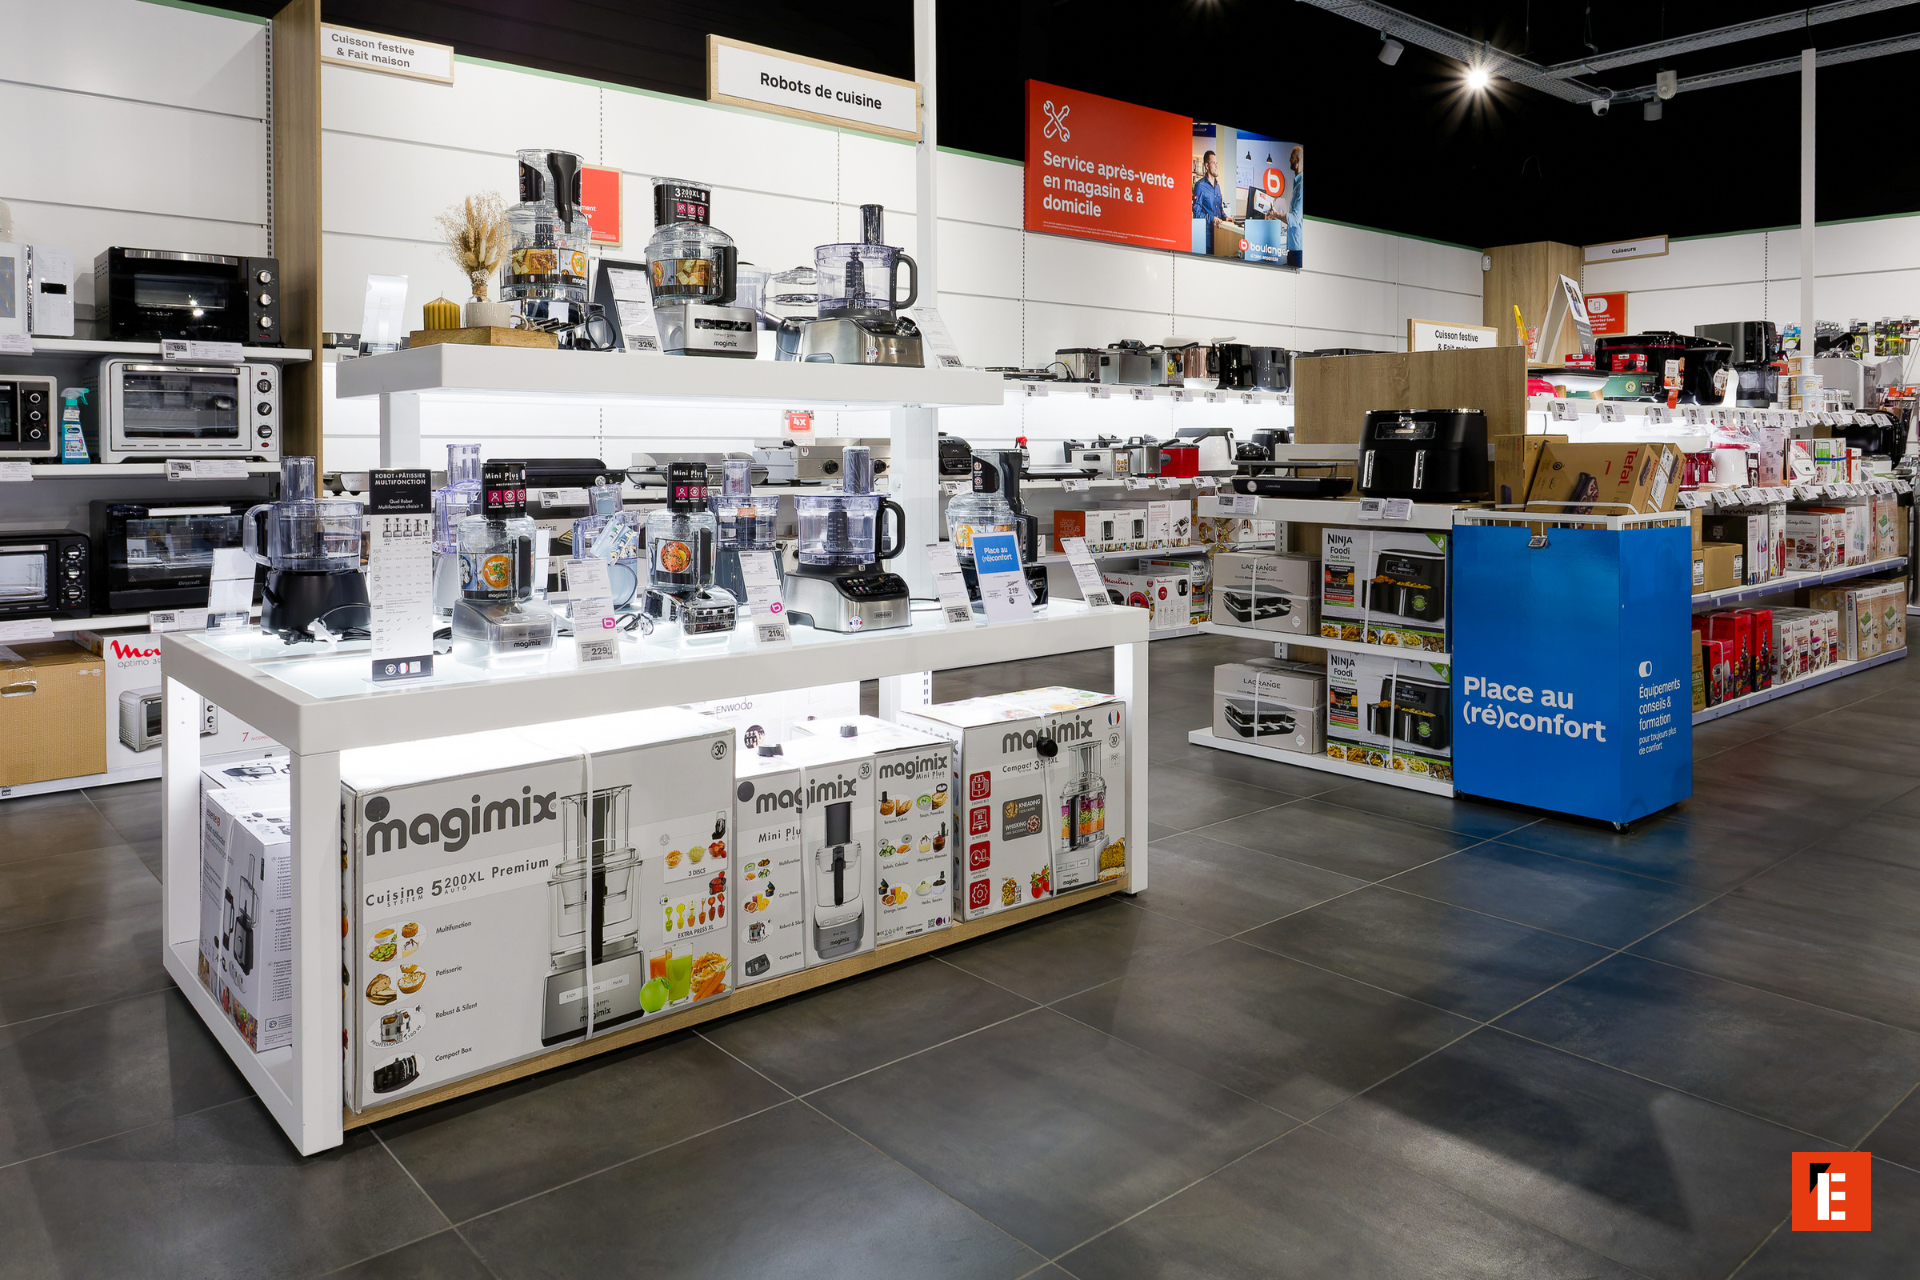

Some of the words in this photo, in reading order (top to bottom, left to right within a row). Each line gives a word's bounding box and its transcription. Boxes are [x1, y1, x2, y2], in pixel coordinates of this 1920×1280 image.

[332, 34, 374, 48] Cuisson
[378, 42, 414, 56] festive
[337, 48, 344, 56] &
[348, 49, 368, 60] Fait
[372, 54, 410, 68] maison
[760, 72, 811, 94] Robots
[815, 84, 832, 99] de
[836, 91, 882, 109] cuisine
[1043, 150, 1094, 174] Service
[1098, 163, 1174, 188] après-vente
[1044, 175, 1060, 189] en
[1064, 177, 1120, 199] magasin
[1124, 187, 1133, 202] &
[1136, 188, 1144, 203] à
[1043, 194, 1101, 217] domicile
[1250, 241, 1290, 257] boulanger
[1435, 330, 1458, 340] Cuisson
[1459, 332, 1478, 342] festive
[1618, 448, 1638, 486] Tefal
[1328, 533, 1353, 547] NINJA
[117, 659, 149, 670] optimo
[1331, 654, 1356, 669] NINJA
[1334, 668, 1353, 677] Foodi
[1464, 676, 1534, 704] Place
[1541, 689, 1573, 710] au
[1639, 678, 1680, 699] Équipements
[716, 701, 753, 714] ENWOOD
[1639, 698, 1666, 715] conseils
[1667, 696, 1671, 708] &
[1463, 700, 1606, 743] (ré)confort
[1639, 713, 1671, 731] formation
[242, 732, 249, 742] 7
[1639, 735, 1650, 746] pour
[1651, 731, 1668, 742] toujours
[714, 744, 724, 756] 30
[1639, 746, 1645, 755] de
[1646, 742, 1662, 754] confort
[880, 753, 947, 779] magimix
[1003, 762, 1032, 772] Compact
[756, 774, 856, 814] magimix
[365, 785, 557, 856] magimix
[759, 830, 780, 842] Mini
[786, 827, 801, 837] Plu
[366, 886, 424, 906] Cuisine
[431, 872, 485, 896] 5200XL
[492, 858, 549, 878] Premium
[445, 886, 467, 894] AUTO
[387, 895, 423, 907] SYSTEM
[436, 921, 471, 934] Multifunction
[678, 930, 692, 938] EXTRA
[694, 927, 707, 936] PRESS
[436, 1009, 454, 1019] Robust
[462, 1002, 477, 1011] Silent
[435, 1050, 460, 1062] Compact
